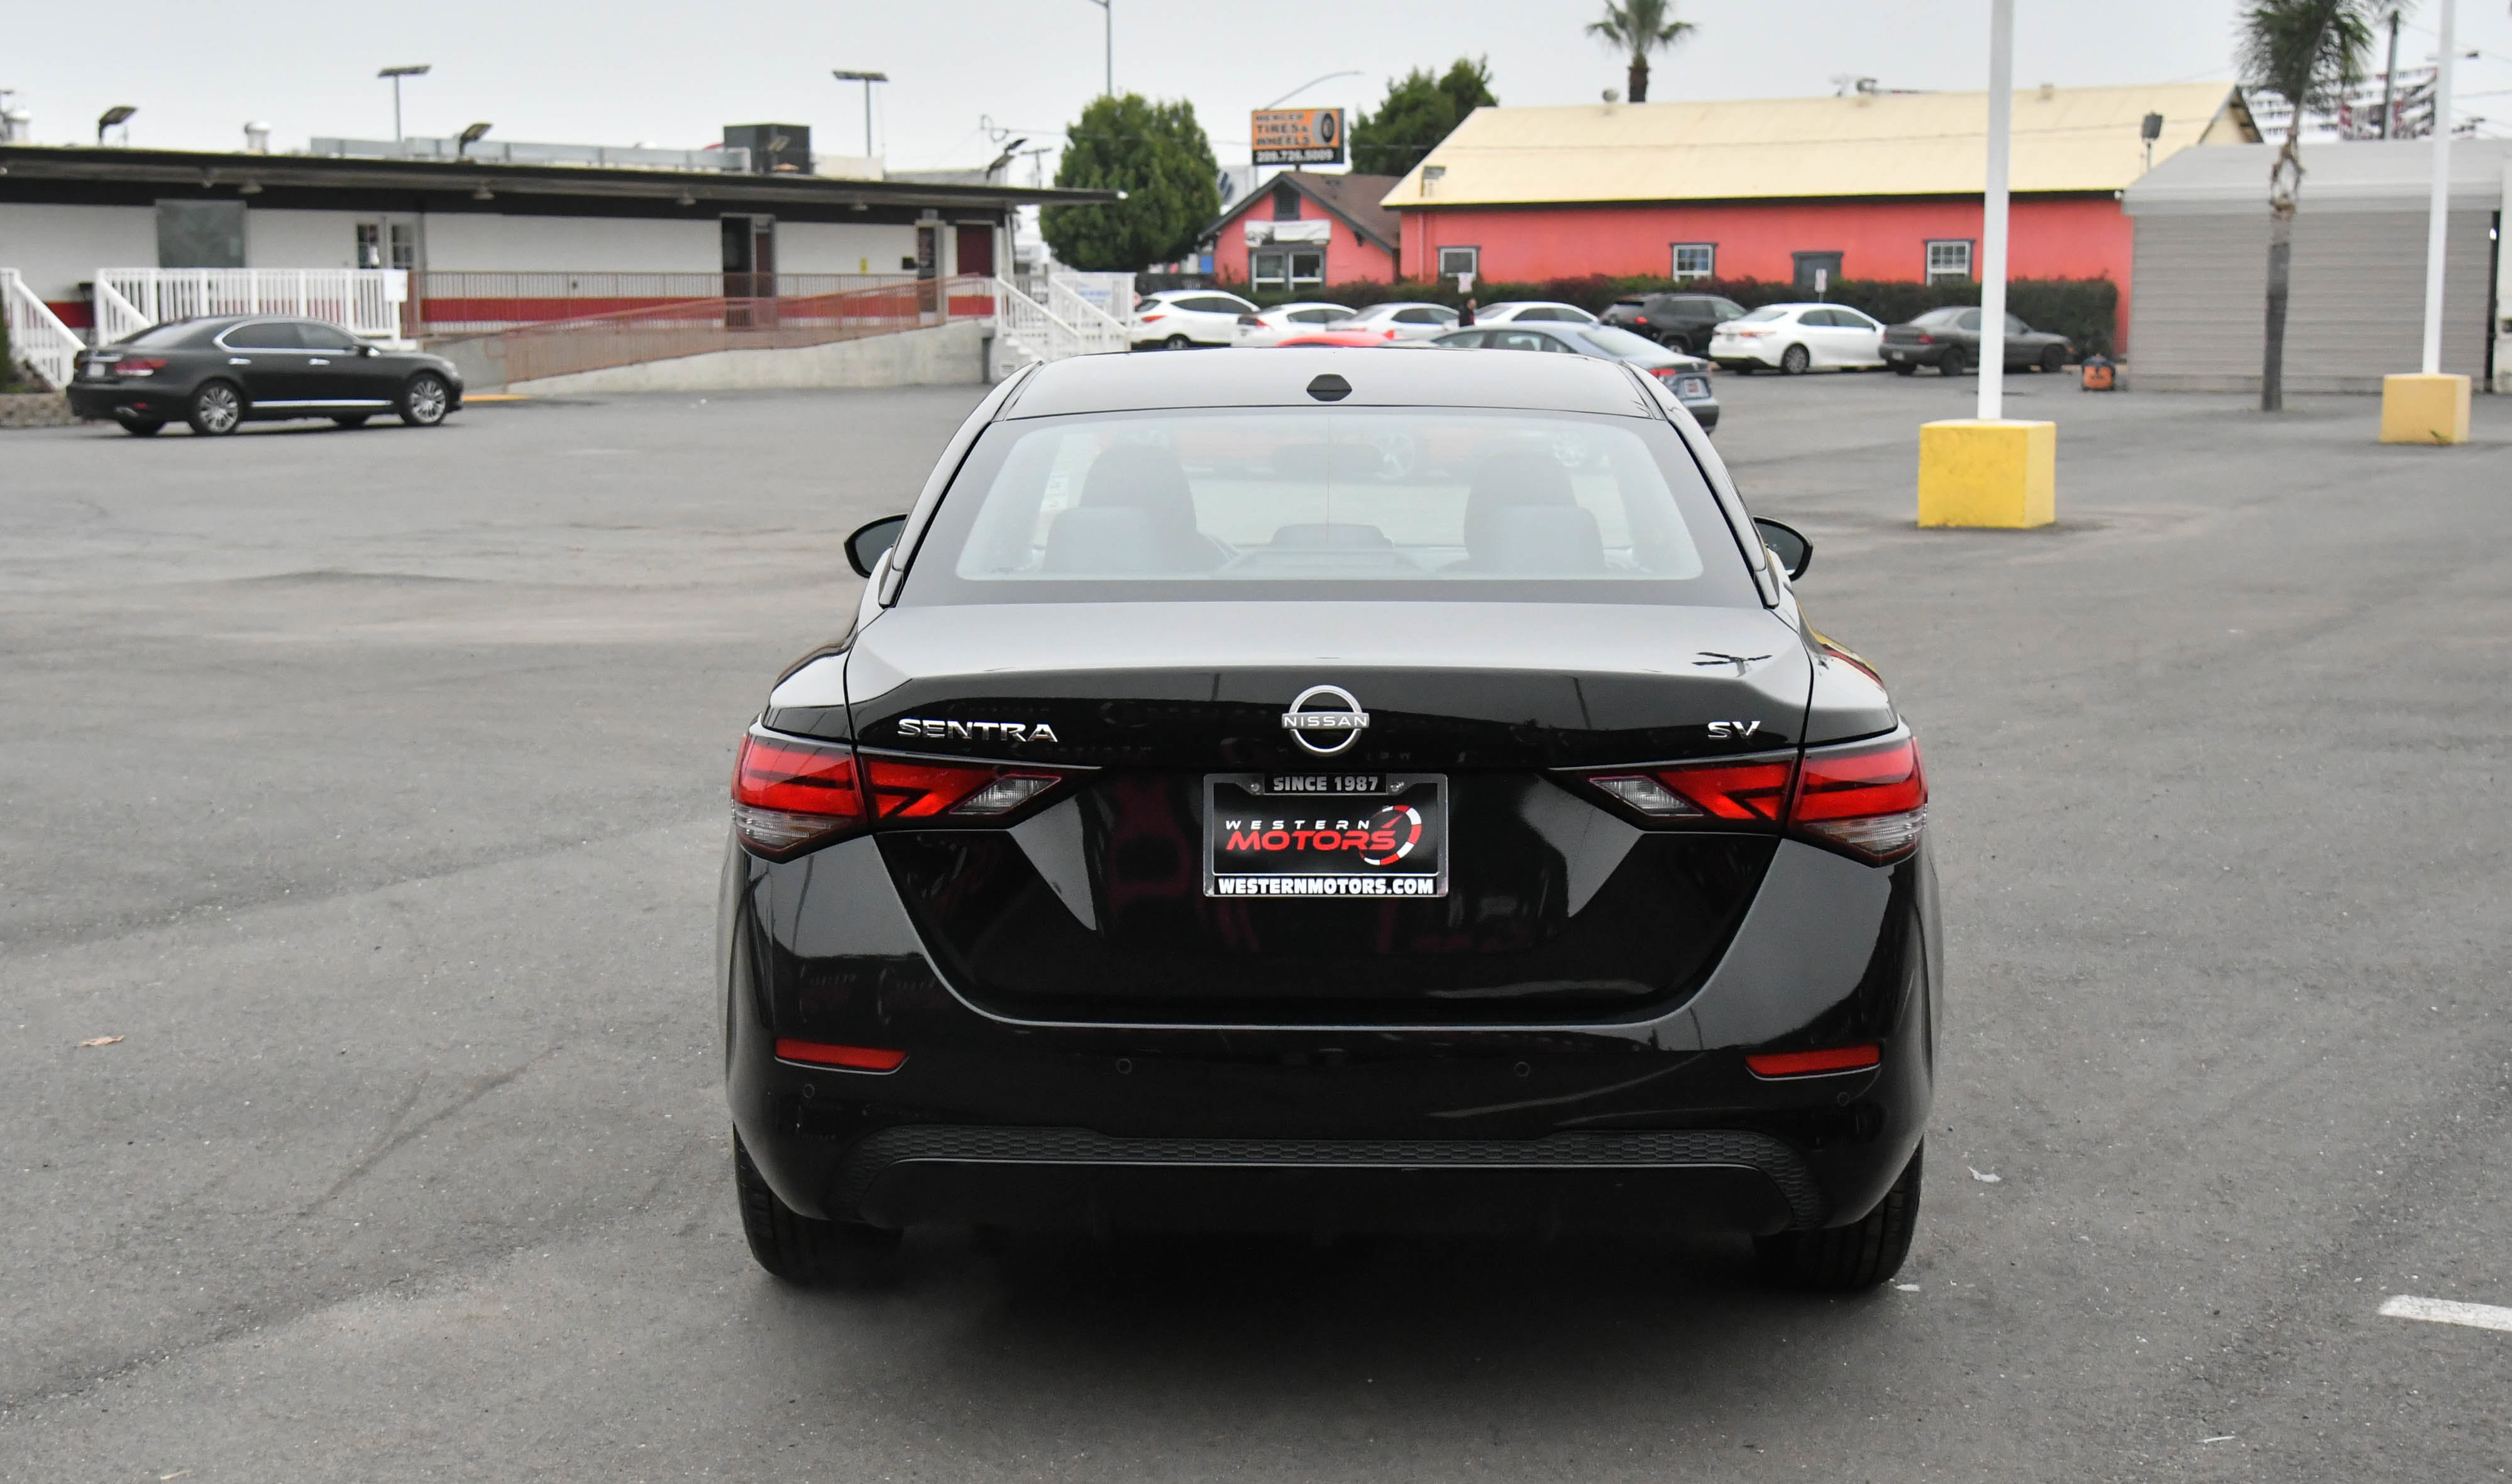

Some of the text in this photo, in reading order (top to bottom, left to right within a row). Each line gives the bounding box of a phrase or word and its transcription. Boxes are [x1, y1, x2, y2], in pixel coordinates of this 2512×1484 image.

[1257, 123, 1299, 133] TIRES
[1256, 136, 1311, 145] WHEELS
[1284, 716, 1367, 727] NISSAN
[897, 718, 1058, 742] SENTRA
[1707, 720, 1760, 739] SV
[1273, 776, 1378, 791] SINCE 1987
[1225, 820, 1369, 830] WESTERN
[1226, 830, 1396, 850] MOTORS
[1218, 878, 1434, 894] WESTERNMOTORS.COM
